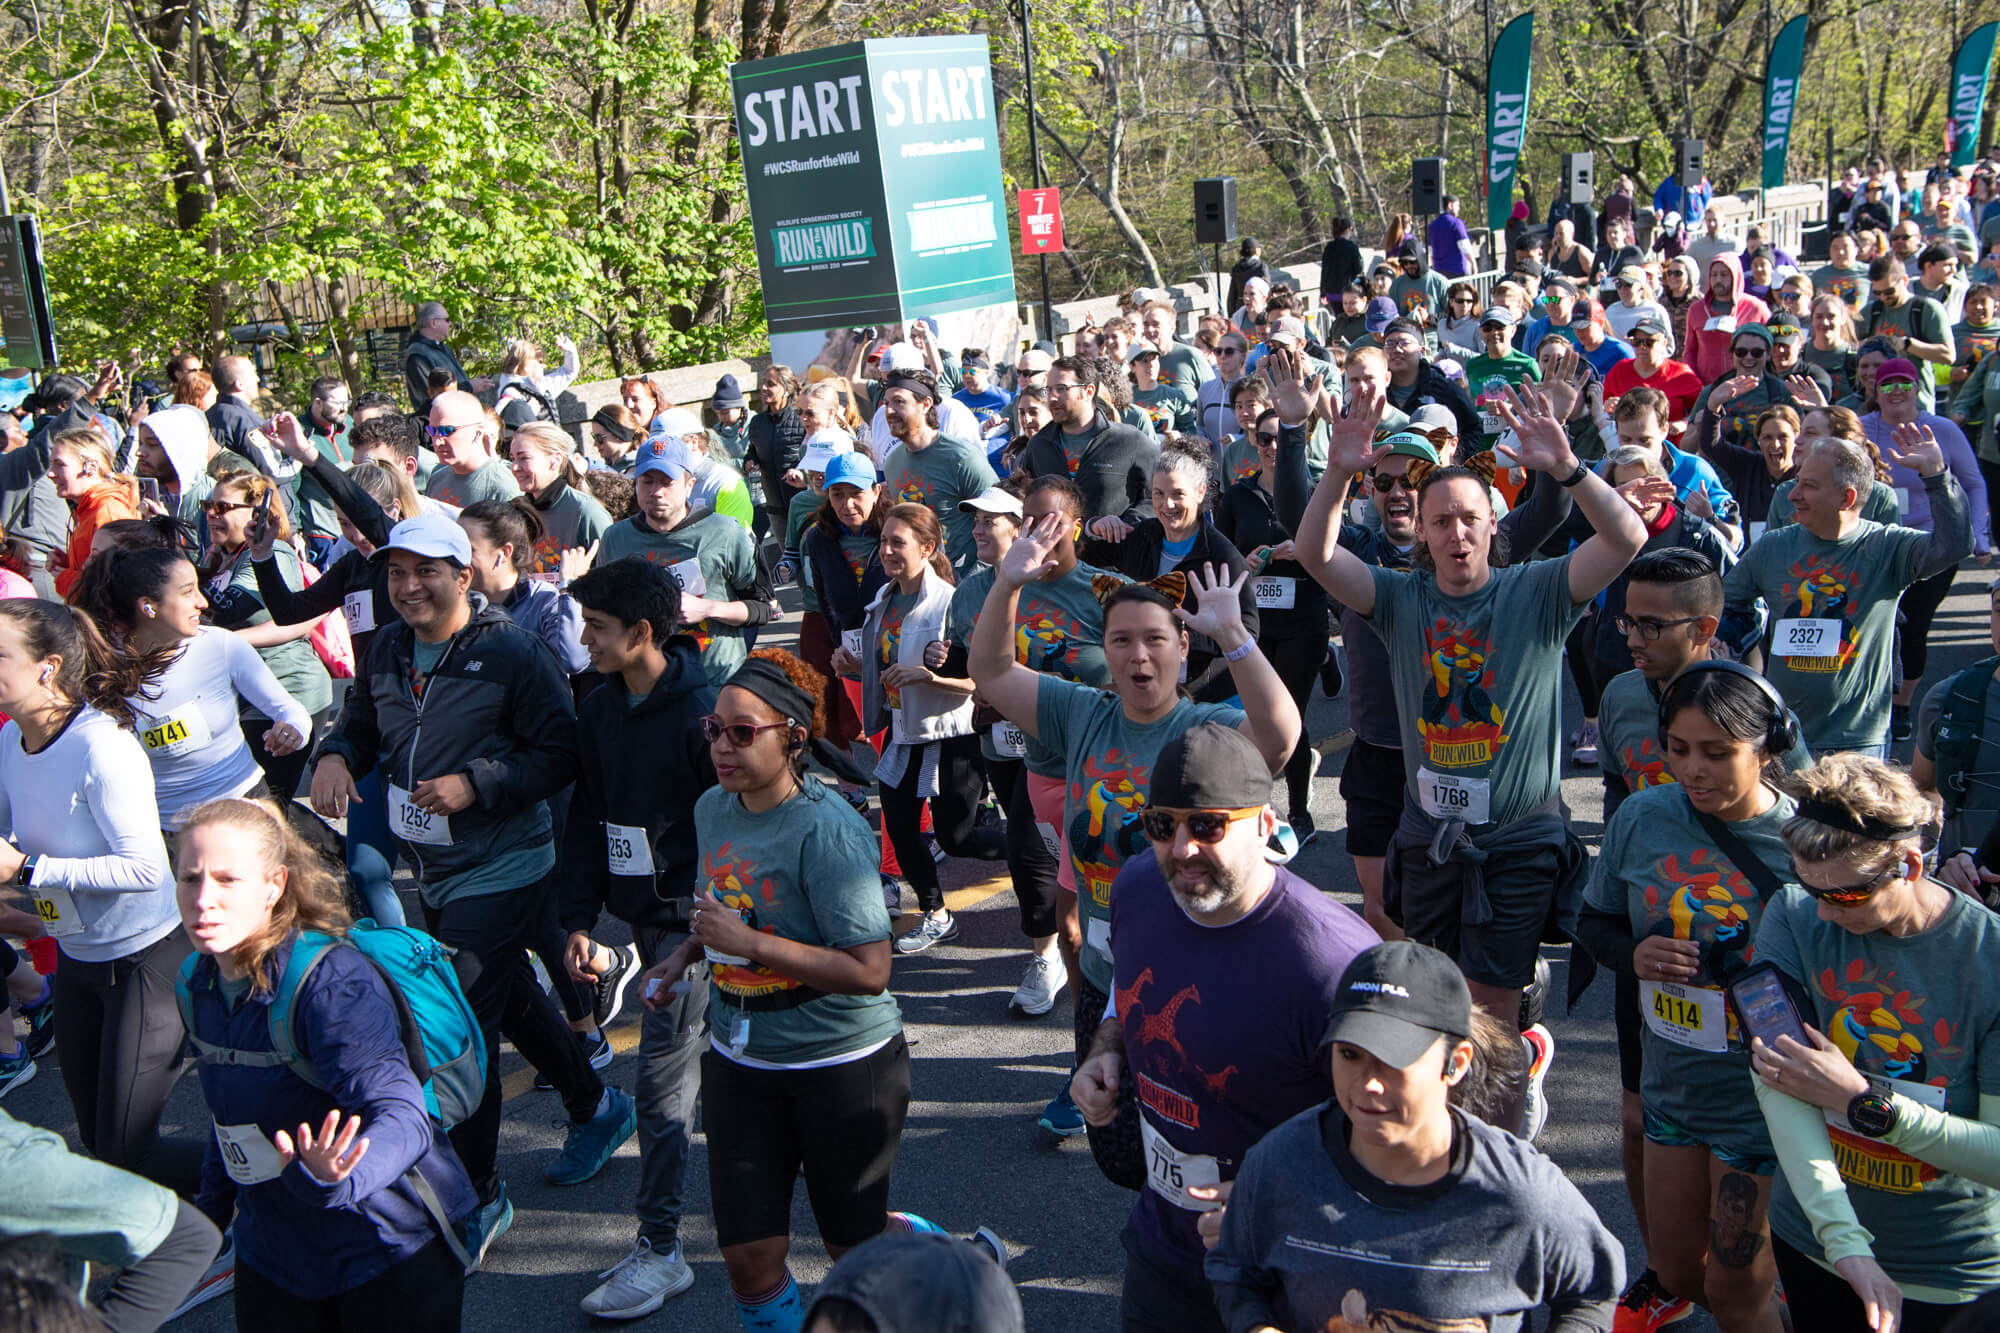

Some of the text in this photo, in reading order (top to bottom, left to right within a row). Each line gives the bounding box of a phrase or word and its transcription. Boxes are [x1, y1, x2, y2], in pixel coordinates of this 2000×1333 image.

[882, 66, 986, 126] START
[744, 75, 862, 146] START
[1765, 77, 1793, 151] START
[1490, 91, 1524, 183] START
[763, 151, 860, 177] #WCSRunfortheWild
[776, 210, 863, 227] WILDLIFE CONSERVATION SOCIETY
[1027, 213, 1054, 225] MINUTE
[1034, 197, 1044, 214] 7
[778, 228, 816, 263] RUN
[820, 222, 867, 258] WILD
[1031, 223, 1052, 235] MILE
[1256, 584, 1282, 597] 2665
[1789, 628, 1824, 644] 2327
[144, 720, 187, 748] 3741
[1433, 743, 1486, 763] RUN WILD
[1432, 785, 1469, 807] 1768
[401, 803, 431, 830] 1252
[1655, 993, 1699, 1028] 4114
[1163, 1093, 1195, 1123] WILD
[1151, 1146, 1183, 1188] 775
[1867, 1158, 1913, 1189] WILD
